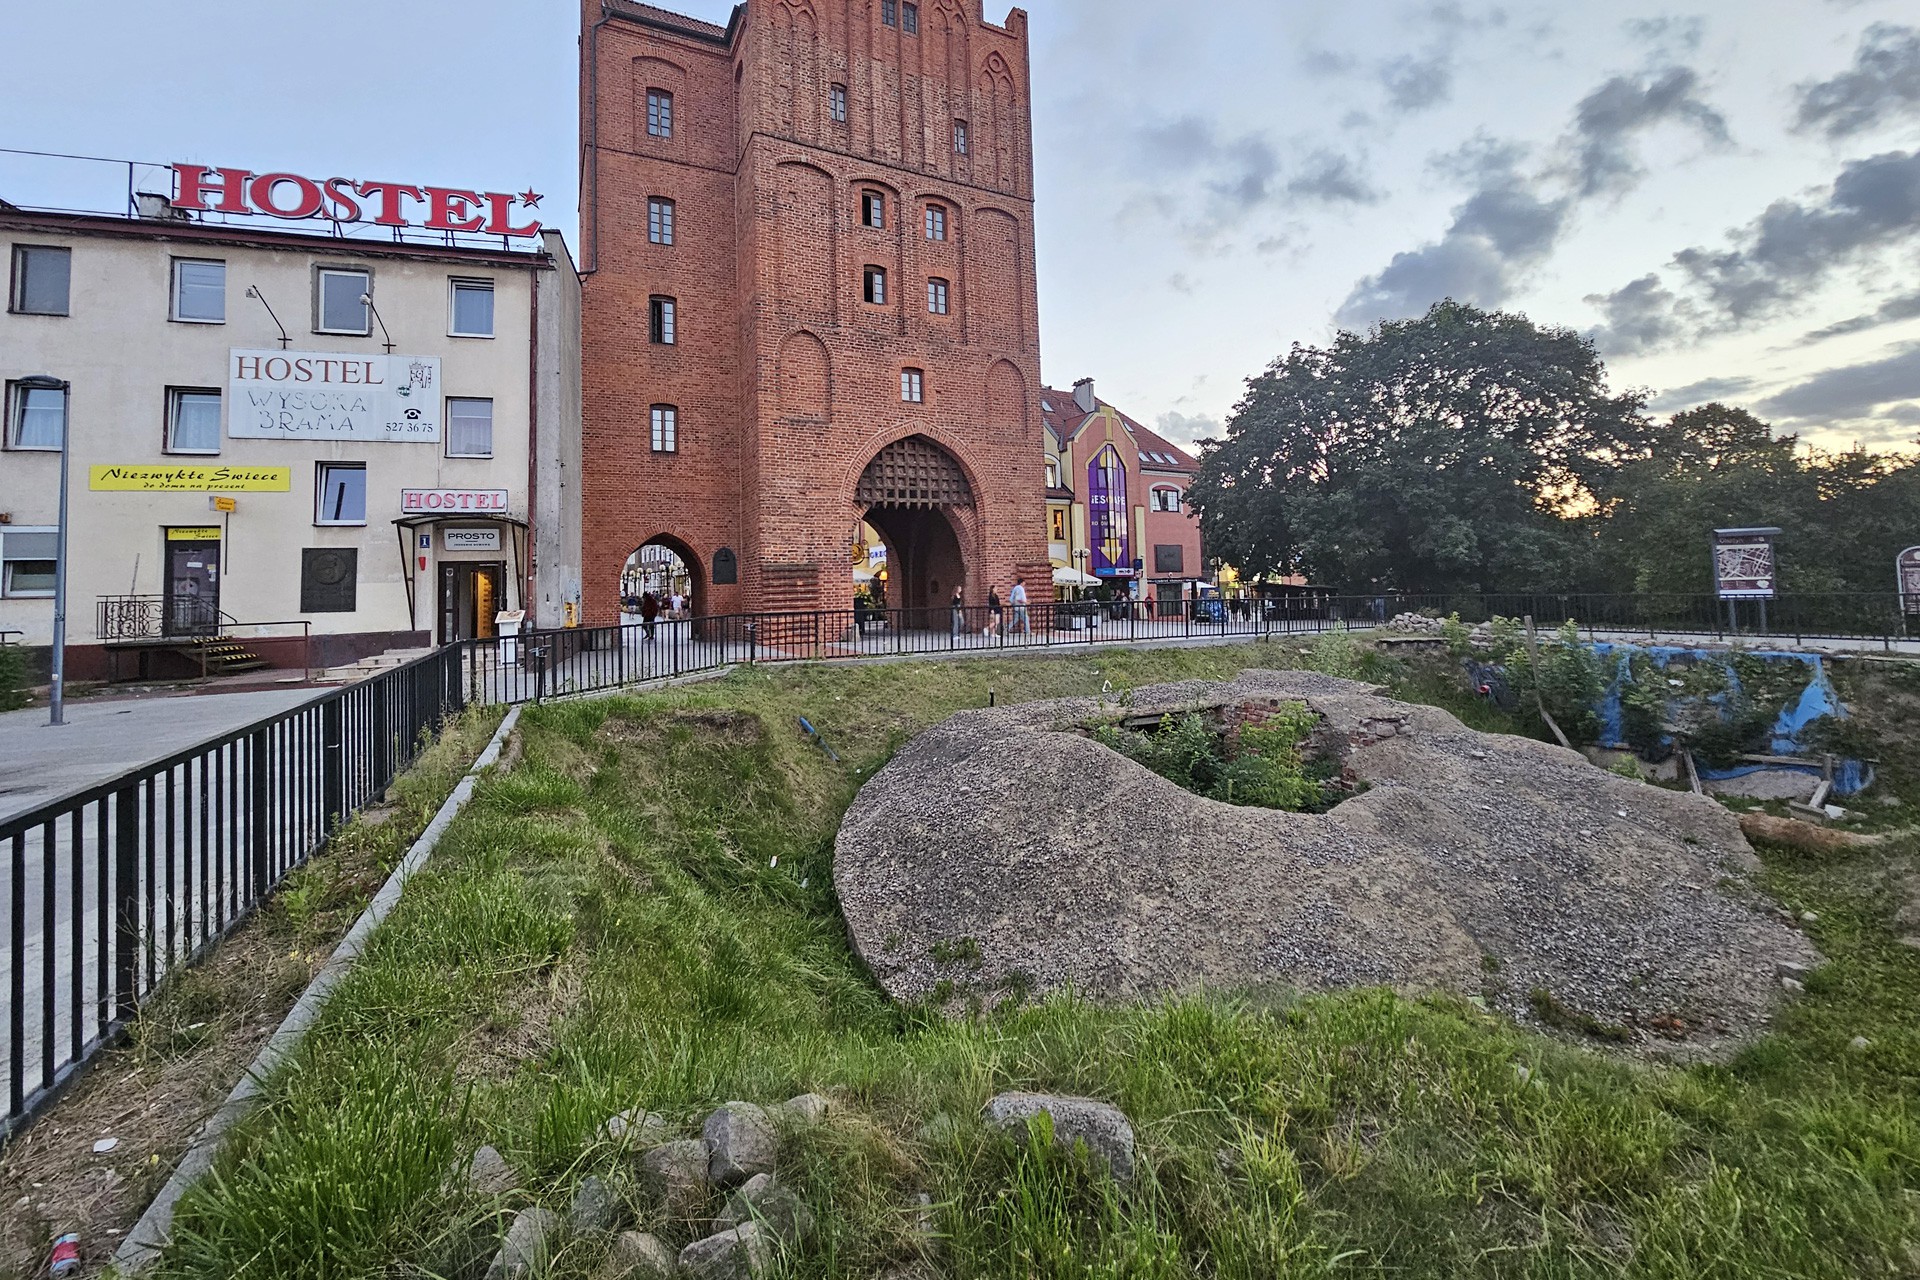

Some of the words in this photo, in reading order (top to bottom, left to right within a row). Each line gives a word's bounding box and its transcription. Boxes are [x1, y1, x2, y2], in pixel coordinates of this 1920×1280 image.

[170, 162, 543, 239] HOSTEL
[235, 355, 384, 385] HOSTEL
[385, 422, 404, 432] 527
[406, 422, 419, 432] 36
[422, 422, 434, 433] 75
[209, 466, 279, 482] Świece
[404, 493, 506, 510] HOSTEL
[447, 532, 495, 540] PROSTO
